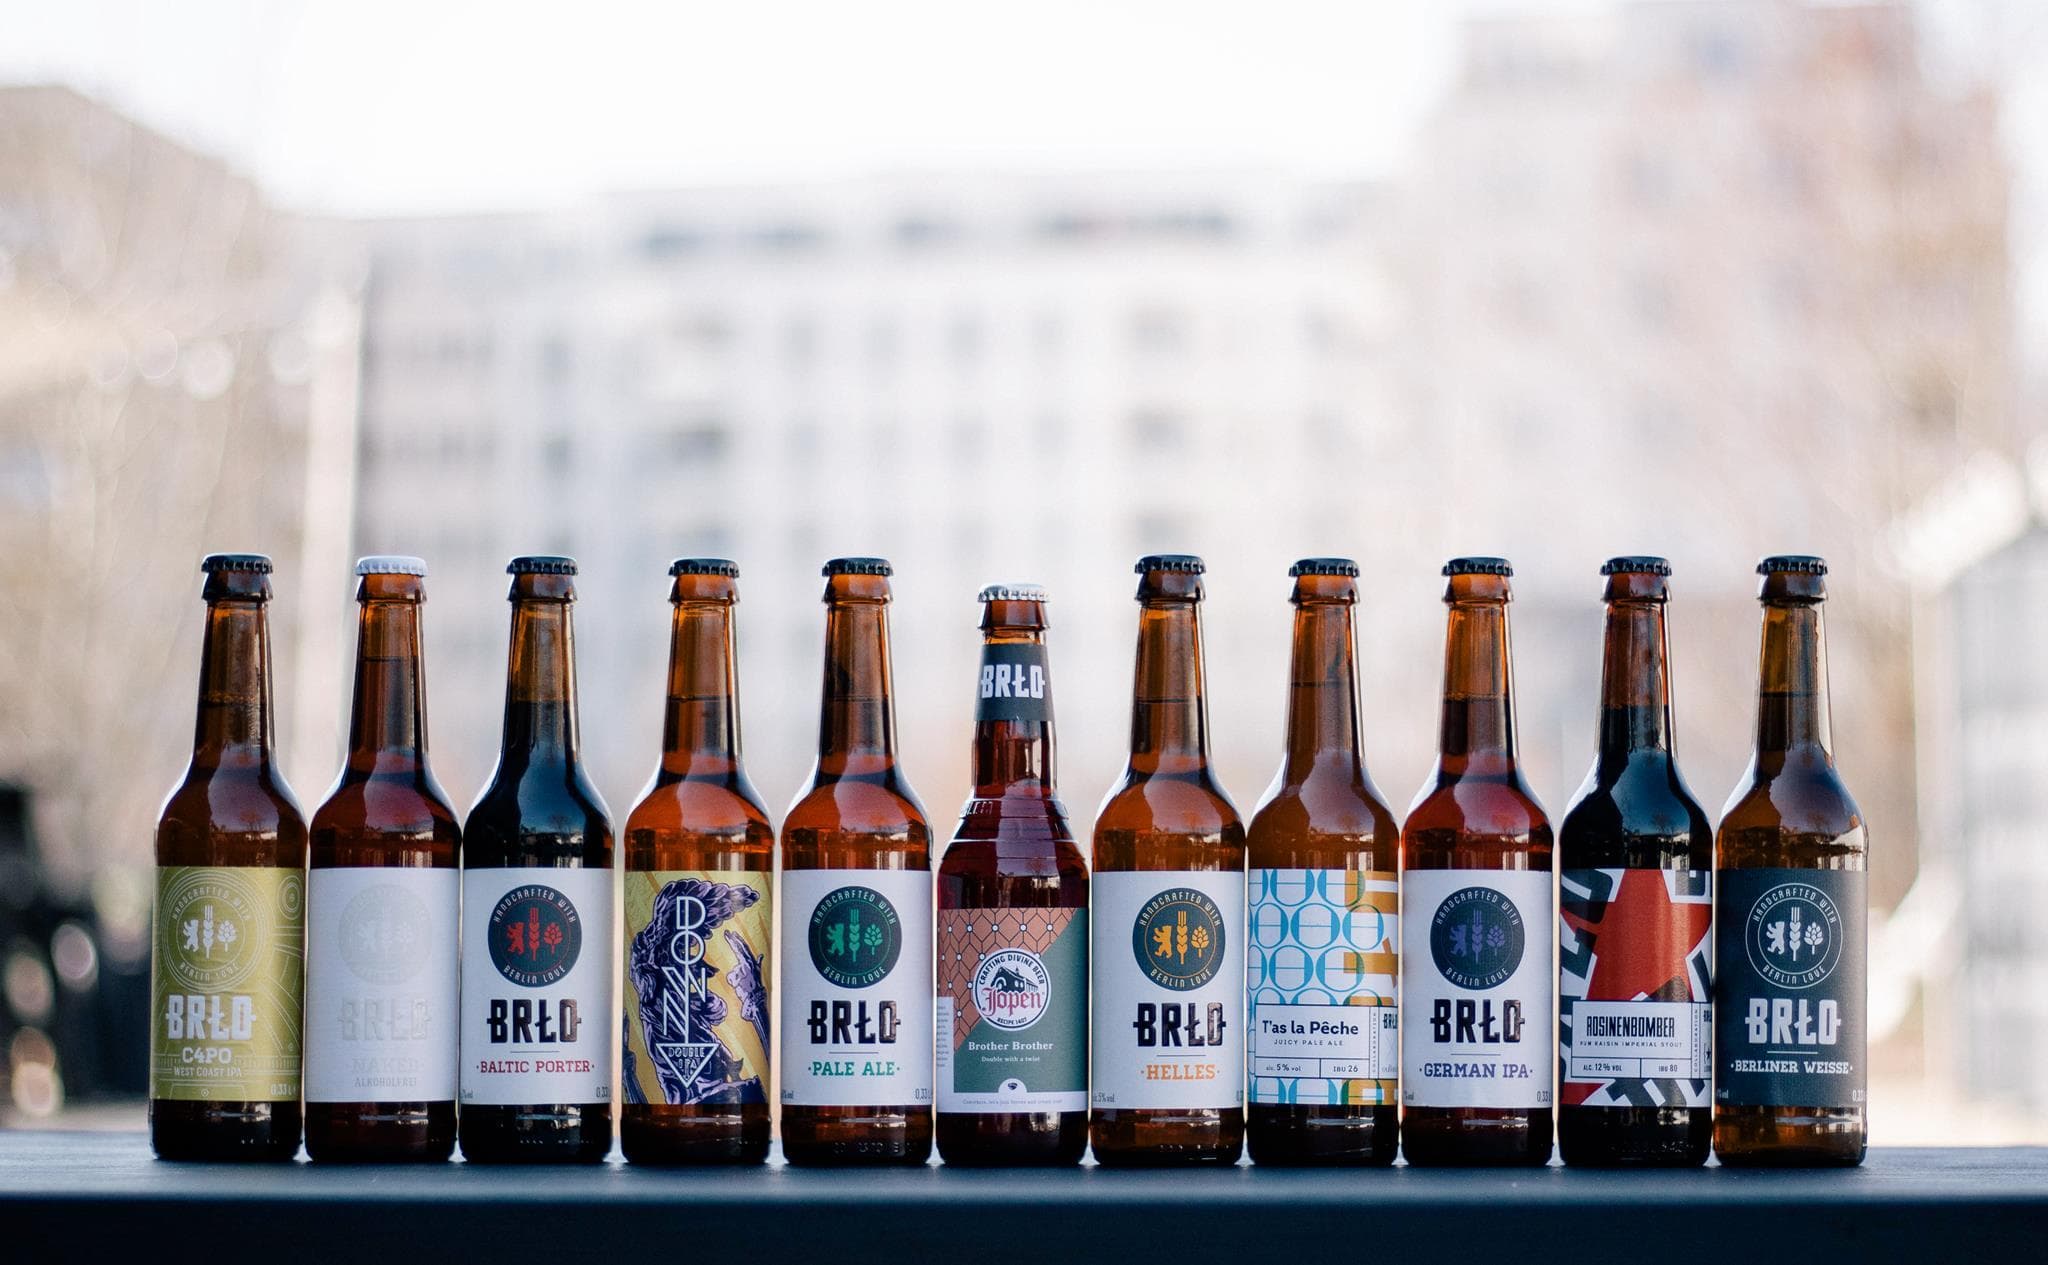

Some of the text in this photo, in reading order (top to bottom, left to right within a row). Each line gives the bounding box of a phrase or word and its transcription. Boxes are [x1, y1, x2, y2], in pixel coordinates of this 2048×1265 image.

[980, 664, 1046, 699] BRŁO
[493, 888, 577, 924] HANDCRAFTED WITH
[813, 889, 897, 925] HANDCRAFTED WITH
[1139, 891, 1221, 927] HANDCRAFTED WITH
[1435, 890, 1519, 926] HANDCRAFTED WITH
[1752, 887, 1837, 924] HANDCRAFTED WITH
[503, 964, 566, 985] BERLIN LOVE
[823, 966, 886, 985] BERLIN LOVE
[979, 954, 1045, 985] CRAFTING DIVINE BEER
[1150, 968, 1213, 988] BERLIN LOVE
[1445, 967, 1508, 987] BERLIN LOVE
[1762, 965, 1826, 984] BERLIN LOVE
[981, 987, 1042, 1017] Jopen
[486, 998, 582, 1044] BRŁO
[807, 999, 901, 1044] BRŁO
[1132, 1002, 1226, 1047] BRŁO
[1262, 1020, 1359, 1035] T'as la Pêche
[1430, 999, 1525, 1043] BRŁO
[1586, 1016, 1675, 1038] ROSINENBOMBER
[1744, 998, 1841, 1045] BRŁO
[182, 1046, 233, 1065] C4PO
[668, 1047, 705, 1057] DOUBLE
[968, 1041, 1054, 1051] Brother Brother
[173, 1066, 242, 1077] WEST COAST IPA
[480, 1060, 590, 1073] BALTIC PORTER
[812, 1061, 895, 1076] PALE ALE
[1146, 1064, 1216, 1080] HELLES
[1333, 1065, 1358, 1073] IBU 26
[1424, 1062, 1529, 1078] GERMAN IPA
[1669, 1064, 1678, 1072] 80
[1734, 1060, 1848, 1075] BERLINER WEISSE
